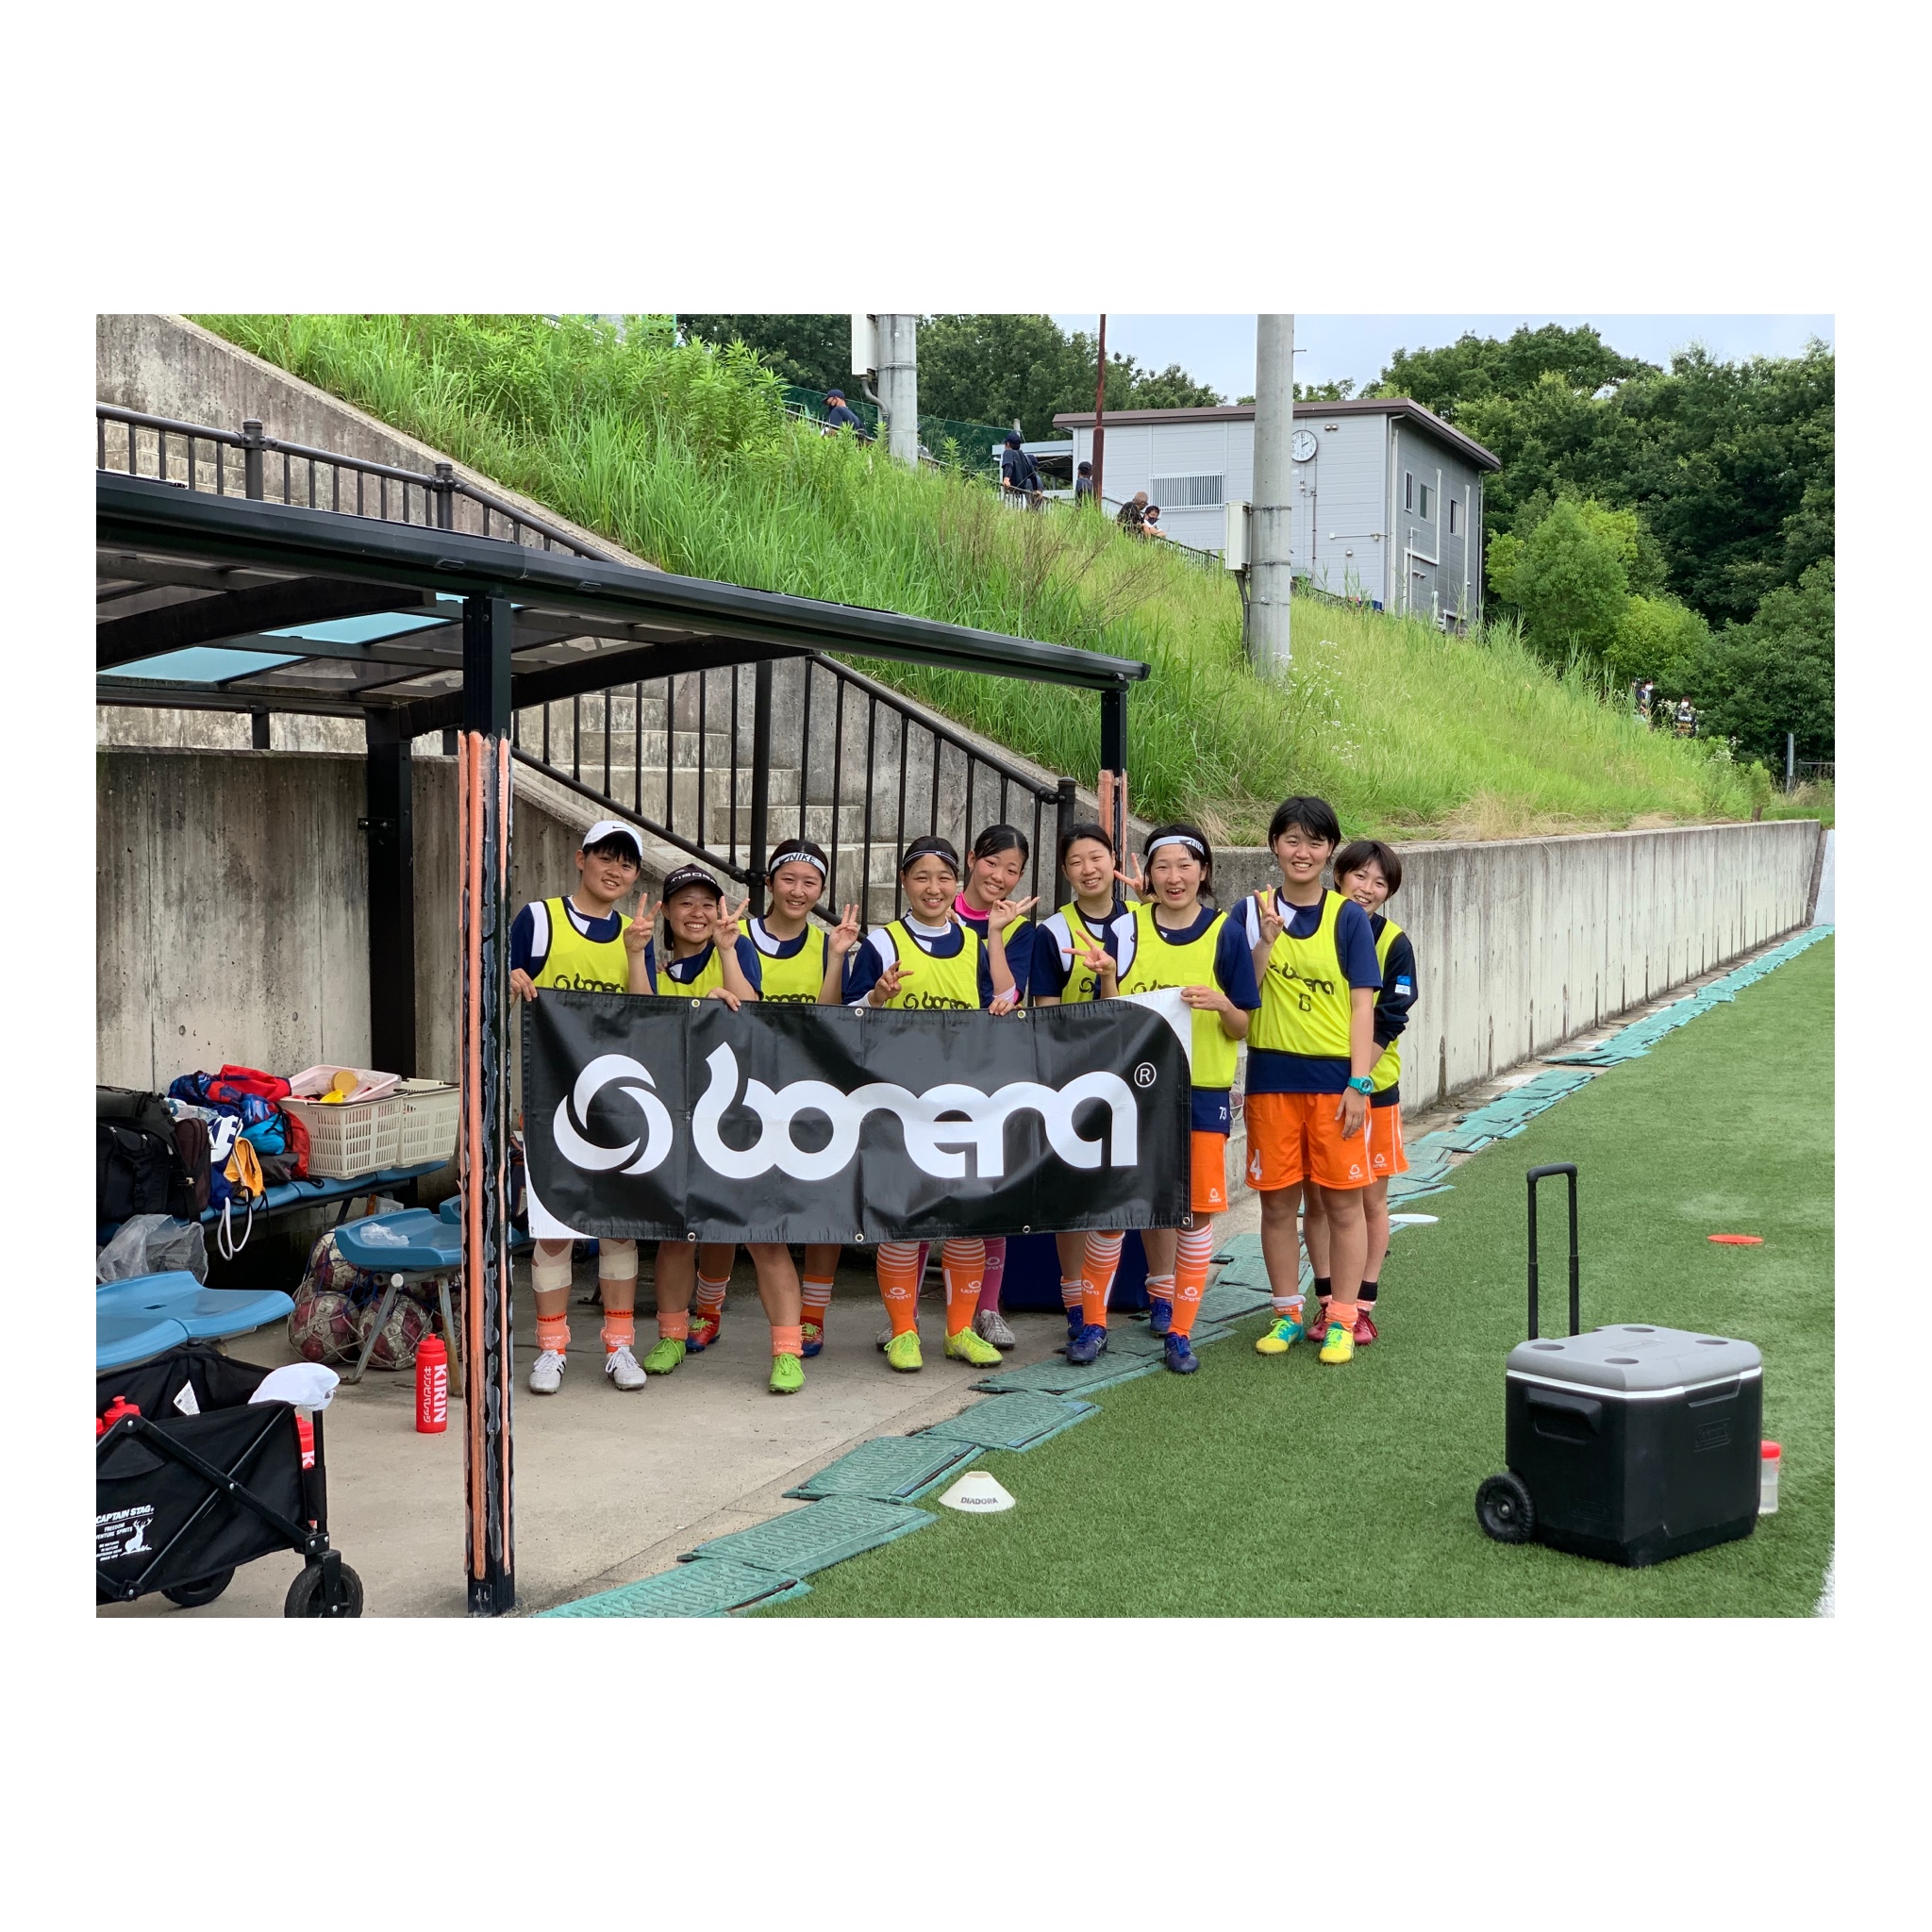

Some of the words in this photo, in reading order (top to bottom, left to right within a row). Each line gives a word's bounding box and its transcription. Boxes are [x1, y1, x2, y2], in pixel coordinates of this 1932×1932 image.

[788, 853, 816, 865] NIKE
[692, 1041, 1138, 1181] bonera
[1249, 1149, 1262, 1180] 4
[423, 1365, 432, 1424] キリンビバレッジ
[433, 1363, 448, 1424] KIRIN
[96, 1509, 130, 1524] CAPTAIN
[130, 1505, 151, 1516] STAG
[960, 1496, 999, 1506] DIADORA
